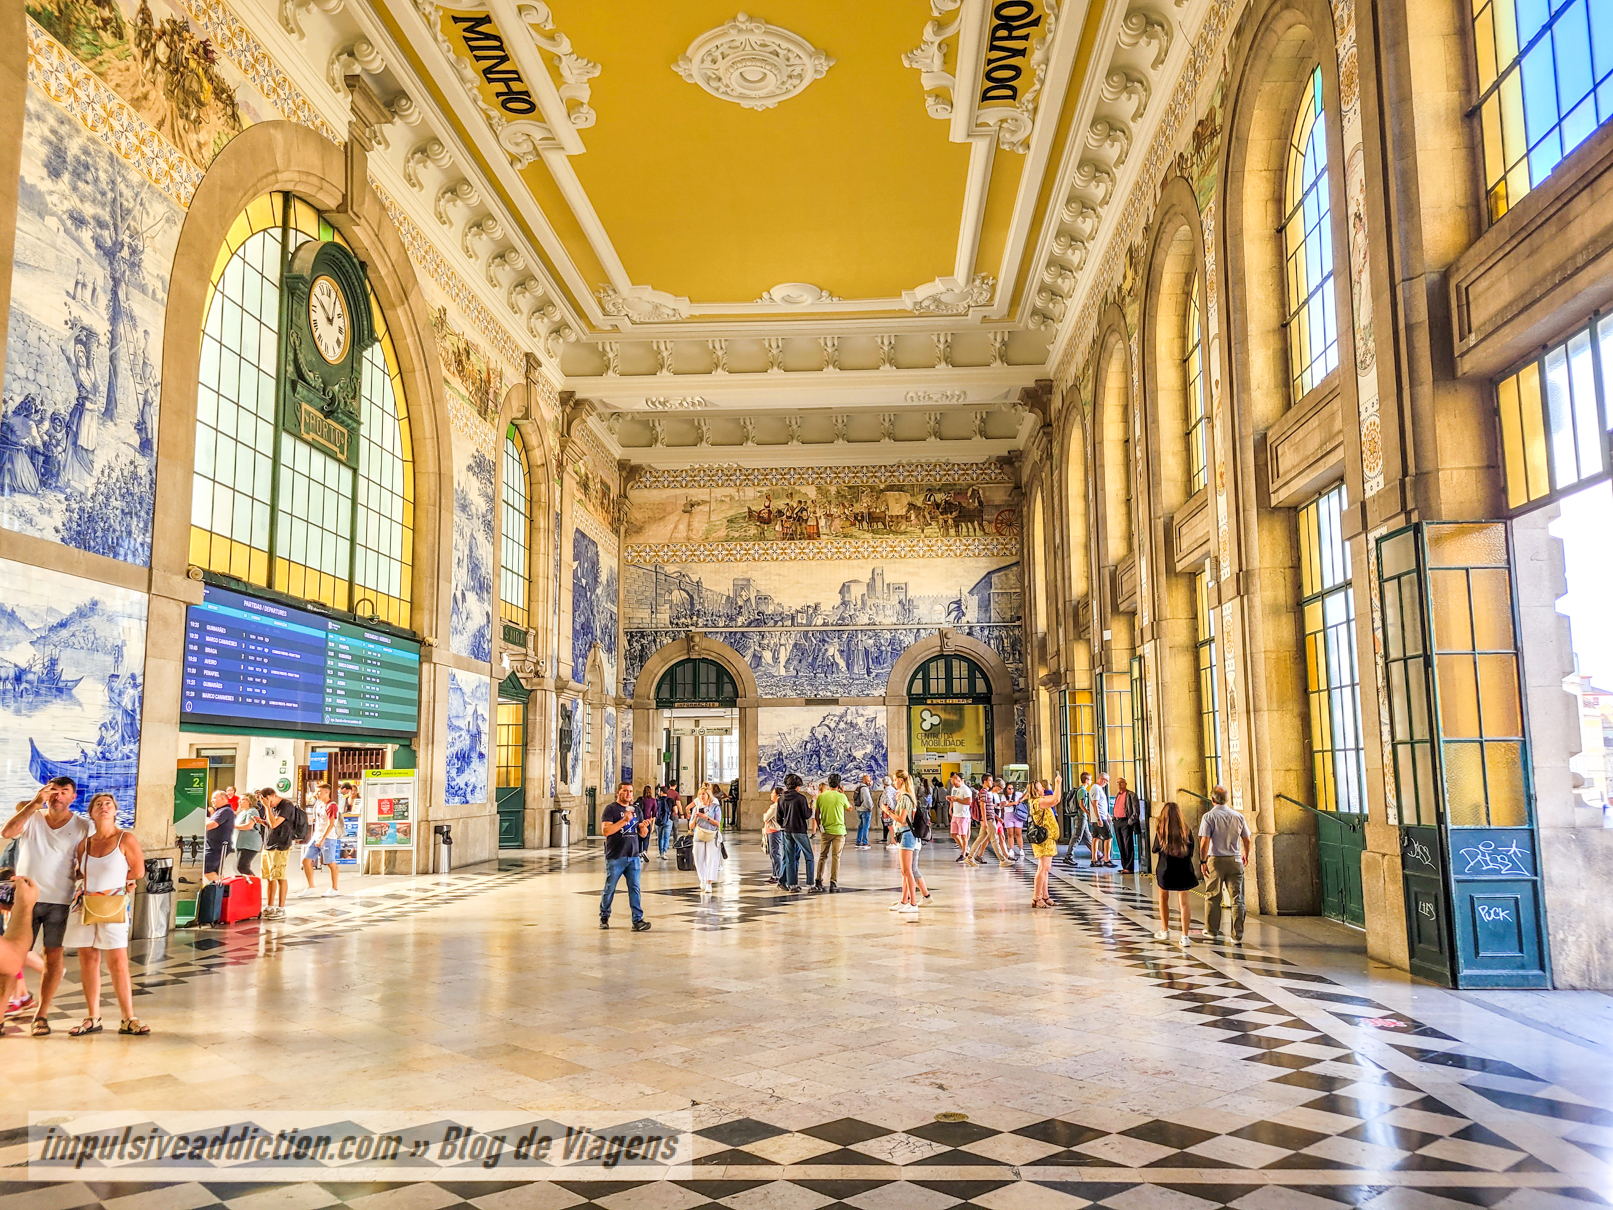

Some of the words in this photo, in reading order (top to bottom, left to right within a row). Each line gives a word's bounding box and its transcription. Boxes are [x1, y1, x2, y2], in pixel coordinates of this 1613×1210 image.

[981, 0, 1042, 103] DOVRO
[451, 14, 536, 115] MINHO
[310, 412, 341, 447] PORTO
[243, 600, 262, 610] PARTIDAS
[264, 605, 288, 617] DEPARTURES
[206, 624, 226, 634] GUIMARÃES
[916, 732, 942, 740] CENTRO
[944, 732, 953, 740] DA
[1478, 905, 1513, 922] PUCK
